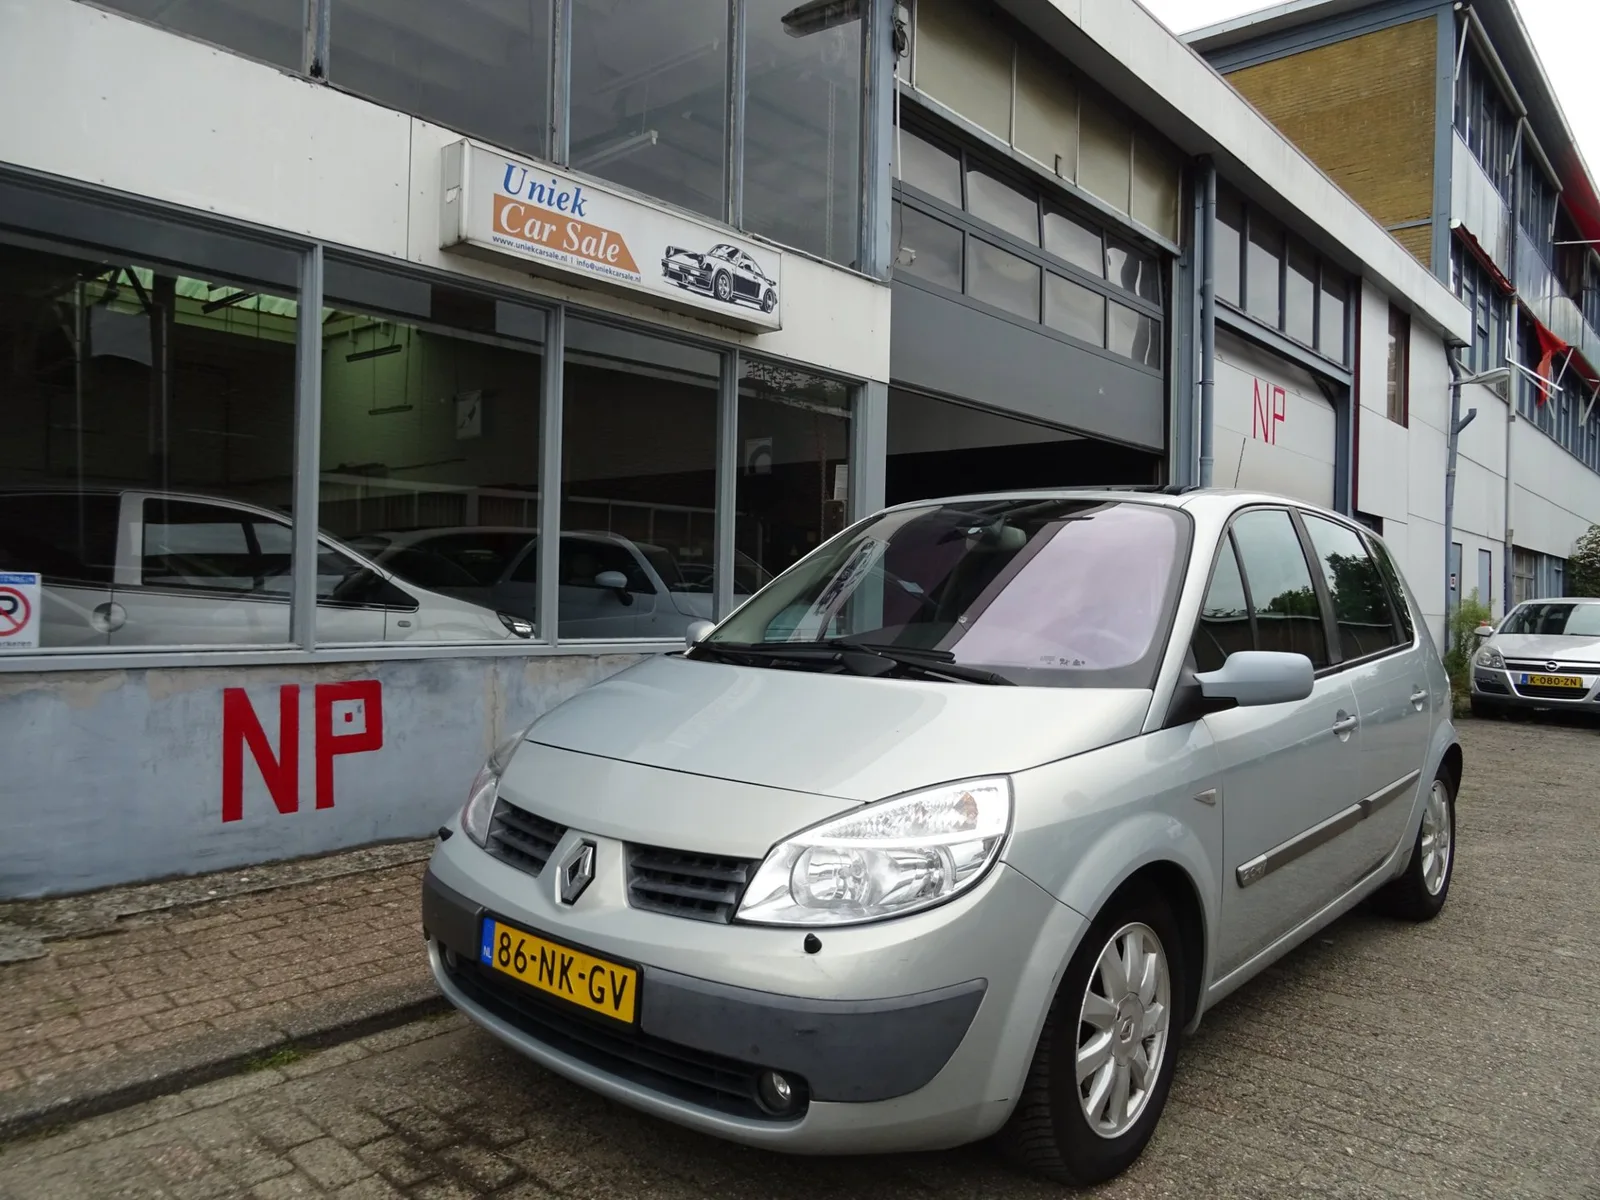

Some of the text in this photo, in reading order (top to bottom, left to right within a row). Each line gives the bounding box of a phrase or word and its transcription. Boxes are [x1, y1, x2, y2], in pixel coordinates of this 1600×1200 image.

[503, 163, 588, 217] Uniek
[492, 235, 568, 263] www.uniekcarsale.nl
[576, 259, 642, 283] info@uniekcarsale.nl
[500, 202, 620, 263] Car Sale
[1252, 377, 1286, 446] NP
[222, 679, 383, 823] NP
[498, 931, 628, 1011] 86-NK-GV
